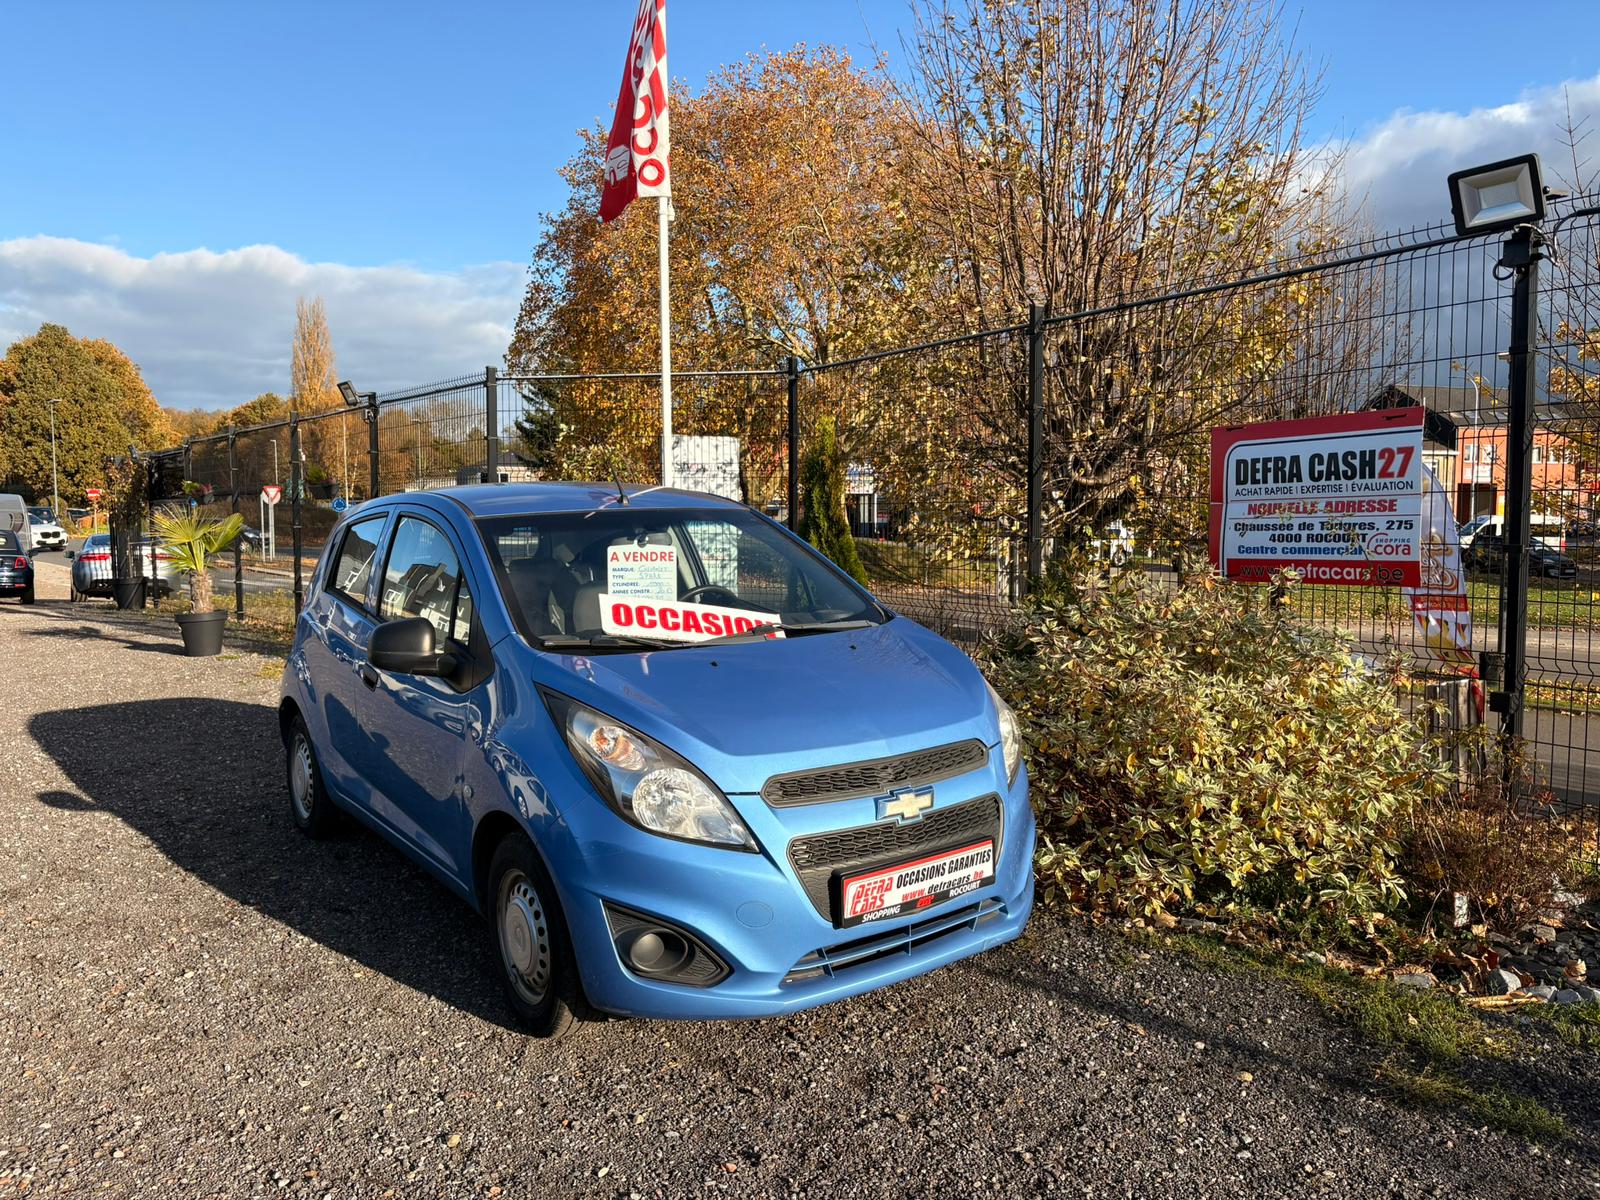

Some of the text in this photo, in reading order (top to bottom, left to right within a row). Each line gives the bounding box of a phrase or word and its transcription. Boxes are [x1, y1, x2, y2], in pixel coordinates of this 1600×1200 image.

[1235, 454, 1303, 486] DEFRA
[1235, 480, 1414, 497] ACHAT RAPIDE EXPERTISE ÉVALUATION
[1324, 499, 1398, 513] ADRESSE
[1300, 521, 1315, 531] de
[1385, 520, 1414, 531] 275
[1269, 533, 1302, 543] 4000
[610, 551, 674, 562] A VENDRE
[1237, 545, 1363, 556] Centre commercial
[1373, 543, 1411, 556] cora
[896, 849, 992, 889] OCCASIONS GARANTIES
[902, 870, 984, 902] www.defracars.be
[949, 880, 982, 898] ROCOURT
[862, 905, 901, 923] SHOPPING
